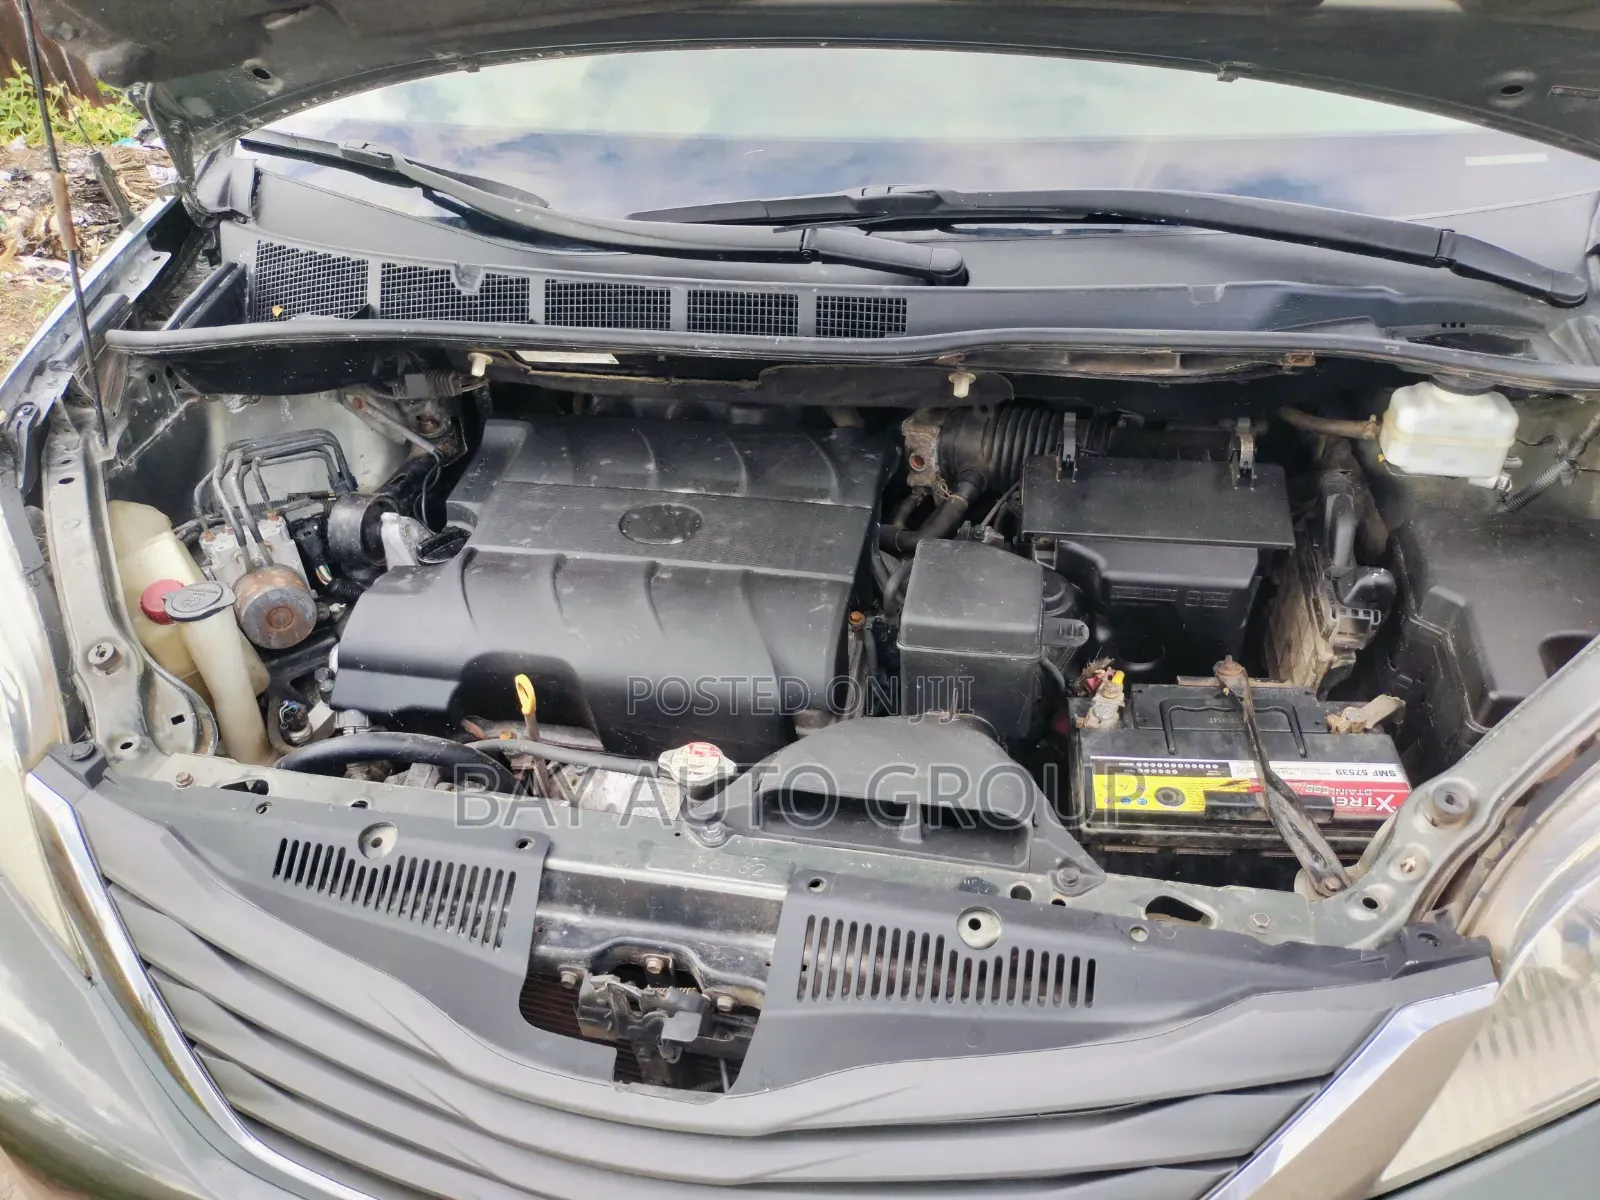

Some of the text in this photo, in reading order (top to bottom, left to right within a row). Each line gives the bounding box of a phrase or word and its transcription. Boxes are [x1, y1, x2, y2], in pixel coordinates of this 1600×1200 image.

[1335, 768, 1368, 776] 57539
[1372, 769, 1396, 777] SMF
[1305, 784, 1373, 796] STAINLESS
[1331, 794, 1396, 813] XTRE
